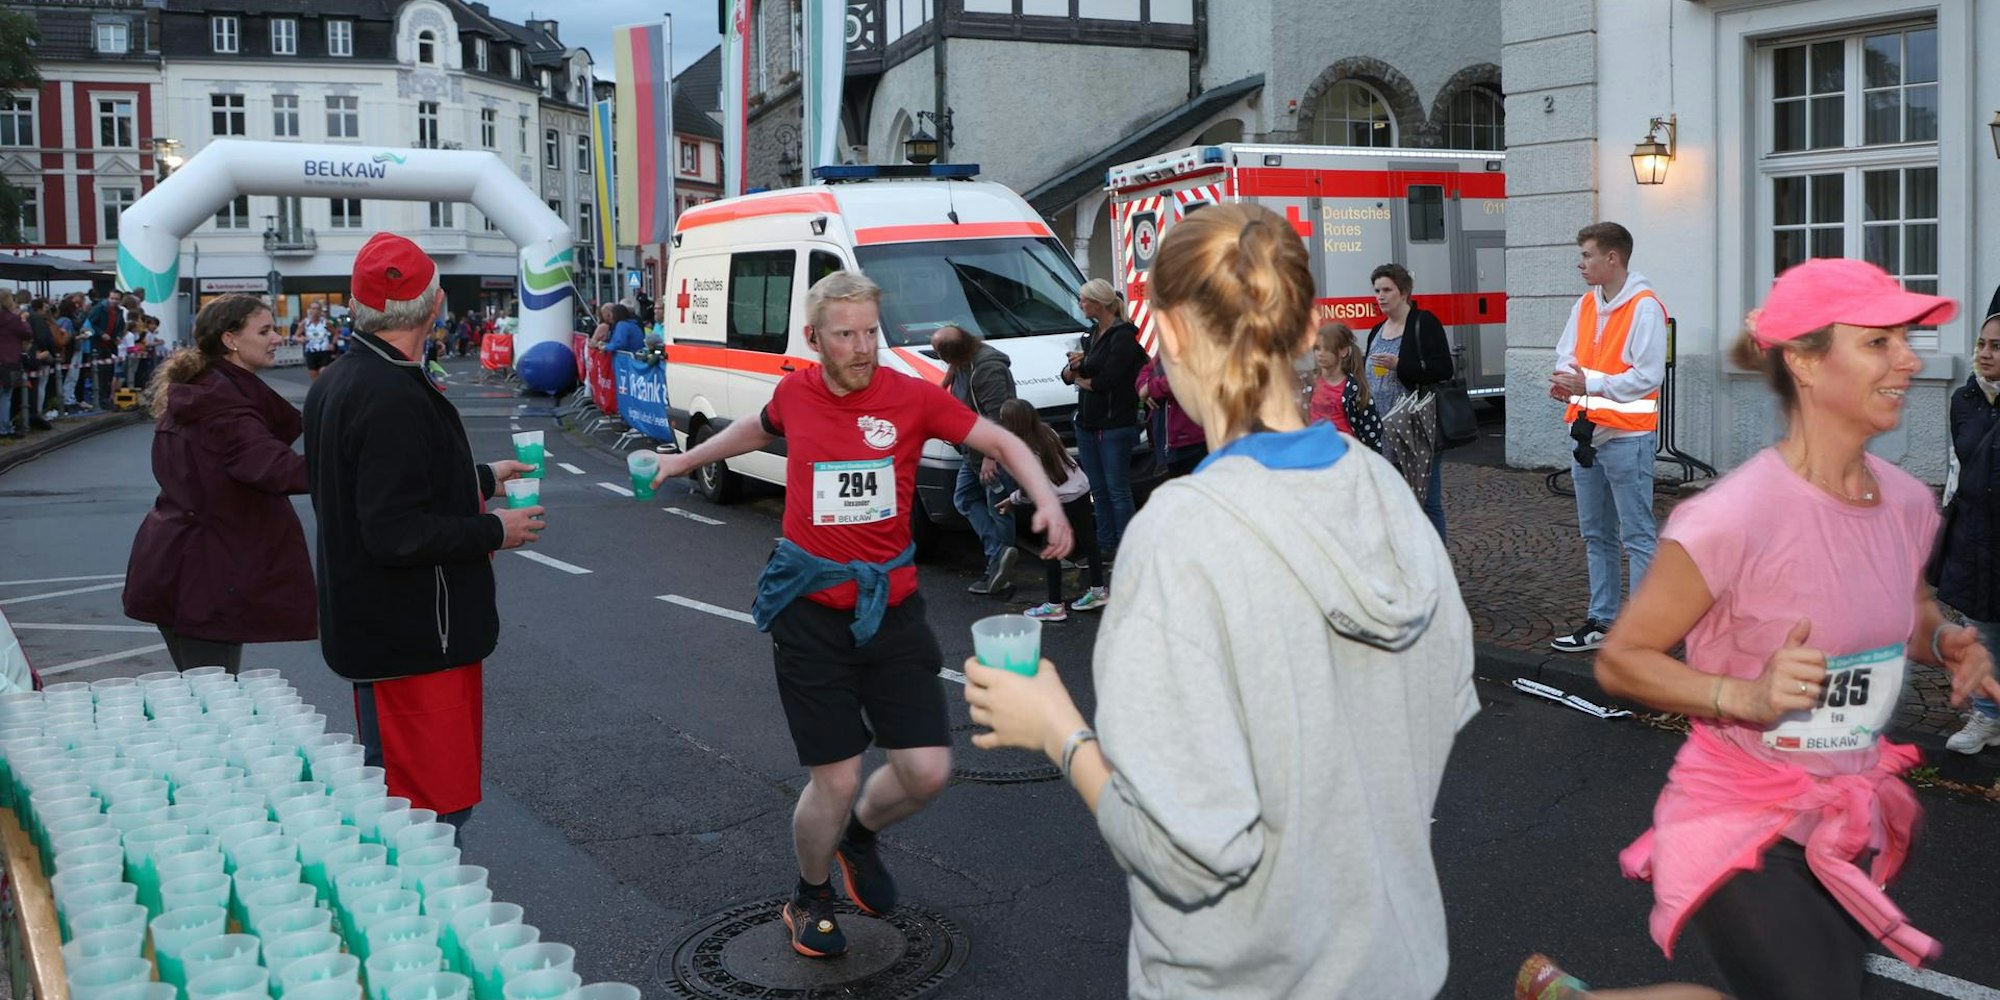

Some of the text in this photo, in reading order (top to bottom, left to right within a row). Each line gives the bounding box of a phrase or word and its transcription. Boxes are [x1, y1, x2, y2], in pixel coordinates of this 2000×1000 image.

[1543, 95, 1555, 113] 2
[304, 160, 386, 178] BELKAW
[1322, 206, 1391, 220] Deutsches
[1323, 222, 1362, 236] Rotes
[1324, 239, 1362, 252] Kreuz
[694, 278, 723, 291] Deutsches
[693, 294, 708, 308] Rotes
[692, 311, 708, 325] Kreuz
[1014, 377, 1054, 387] tsches
[838, 471, 877, 498] 294
[838, 514, 871, 522] BELKAW
[1831, 712, 1845, 723] Eva
[1806, 736, 1859, 749] BELKAW
